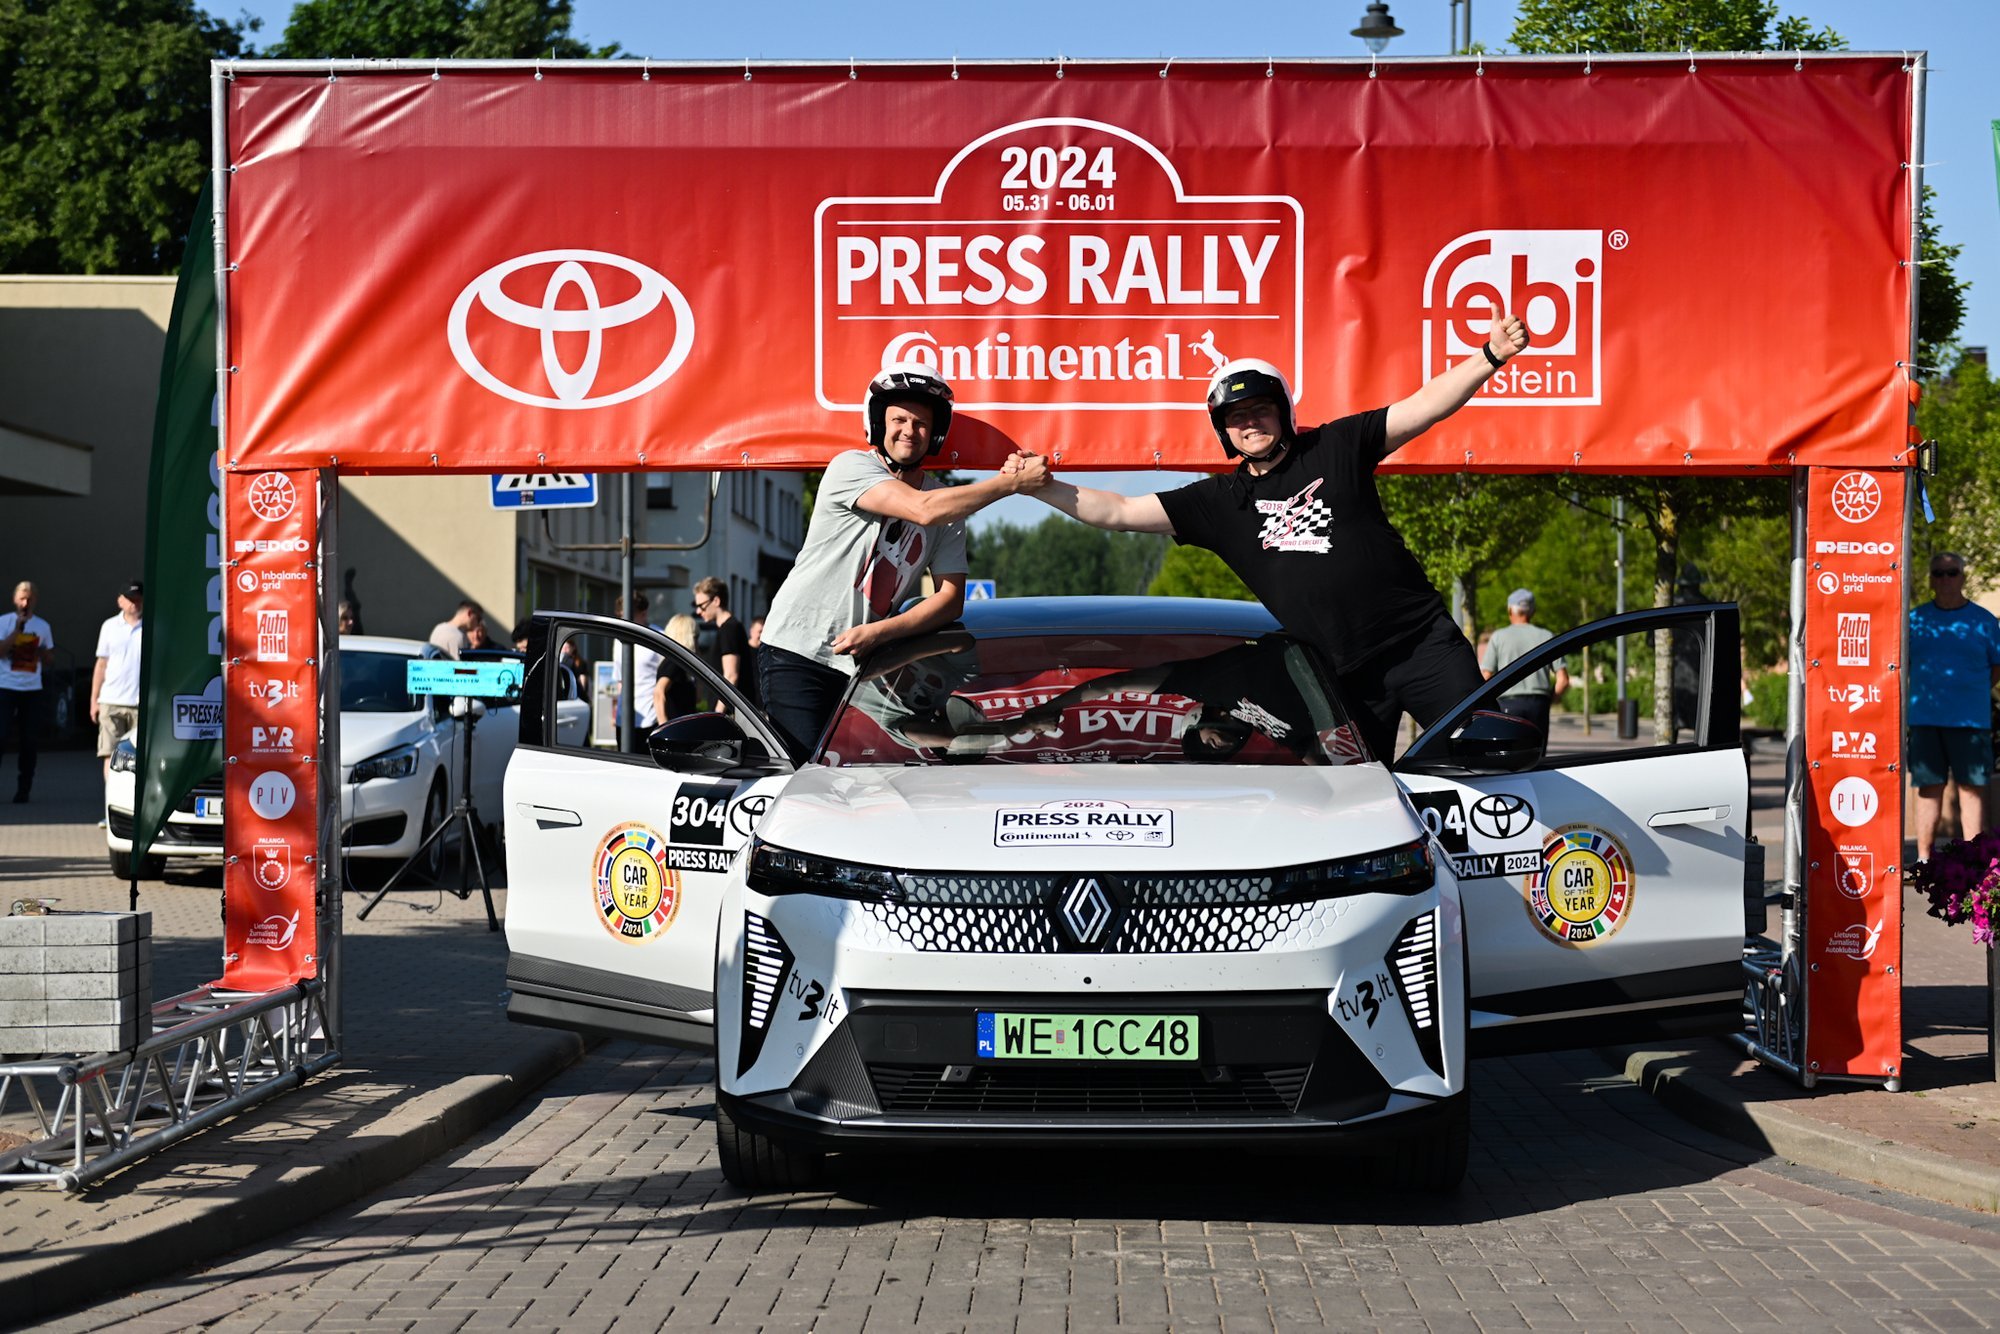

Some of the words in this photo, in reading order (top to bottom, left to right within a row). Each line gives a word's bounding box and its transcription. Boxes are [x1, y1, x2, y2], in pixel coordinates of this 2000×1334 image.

[1000, 146, 1117, 189] 2024
[1002, 194, 1049, 211] 05.31
[1068, 194, 1115, 211] 06.01
[836, 234, 1048, 305] PRESS
[1069, 234, 1281, 304] RALLY
[1423, 238, 1596, 356] febi
[881, 329, 1182, 382] Continental
[263, 490, 282, 503] TA
[1847, 491, 1864, 504] TA
[1260, 502, 1283, 511] 2018
[235, 540, 310, 552] REDGO
[1815, 541, 1895, 554] REDGO
[261, 570, 308, 580] Inbalance
[1843, 572, 1893, 583] Inbalance
[261, 580, 281, 592] grid
[1843, 583, 1864, 594] grid
[258, 613, 287, 634] Auto
[1838, 616, 1869, 637] Auto
[260, 635, 286, 653] Bild
[1841, 639, 1867, 657] Bild
[248, 679, 299, 708] tv3.lt
[1828, 684, 1881, 713] tv3.lt
[671, 796, 726, 829] 304
[1002, 812, 1080, 826] PRESS
[1087, 812, 1164, 826] RALLY
[1421, 804, 1467, 838] 04
[1000, 831, 1080, 843] Continental
[668, 849, 707, 869] PRESS
[1454, 856, 1499, 878] RALLY
[1507, 855, 1538, 870] 2024
[623, 864, 648, 886] CAR
[1564, 868, 1594, 888] CAR
[634, 885, 648, 893] THE
[623, 893, 648, 909] YEAR
[1564, 897, 1595, 911] YEAR
[623, 922, 642, 935] 2024
[1571, 928, 1593, 938] 2024
[789, 969, 839, 1025] tv3.lt
[1337, 973, 1394, 1030] tv3.lt
[979, 1040, 993, 1051] PL
[1003, 1018, 1052, 1055] WE
[1072, 1019, 1190, 1056] 1CC48
